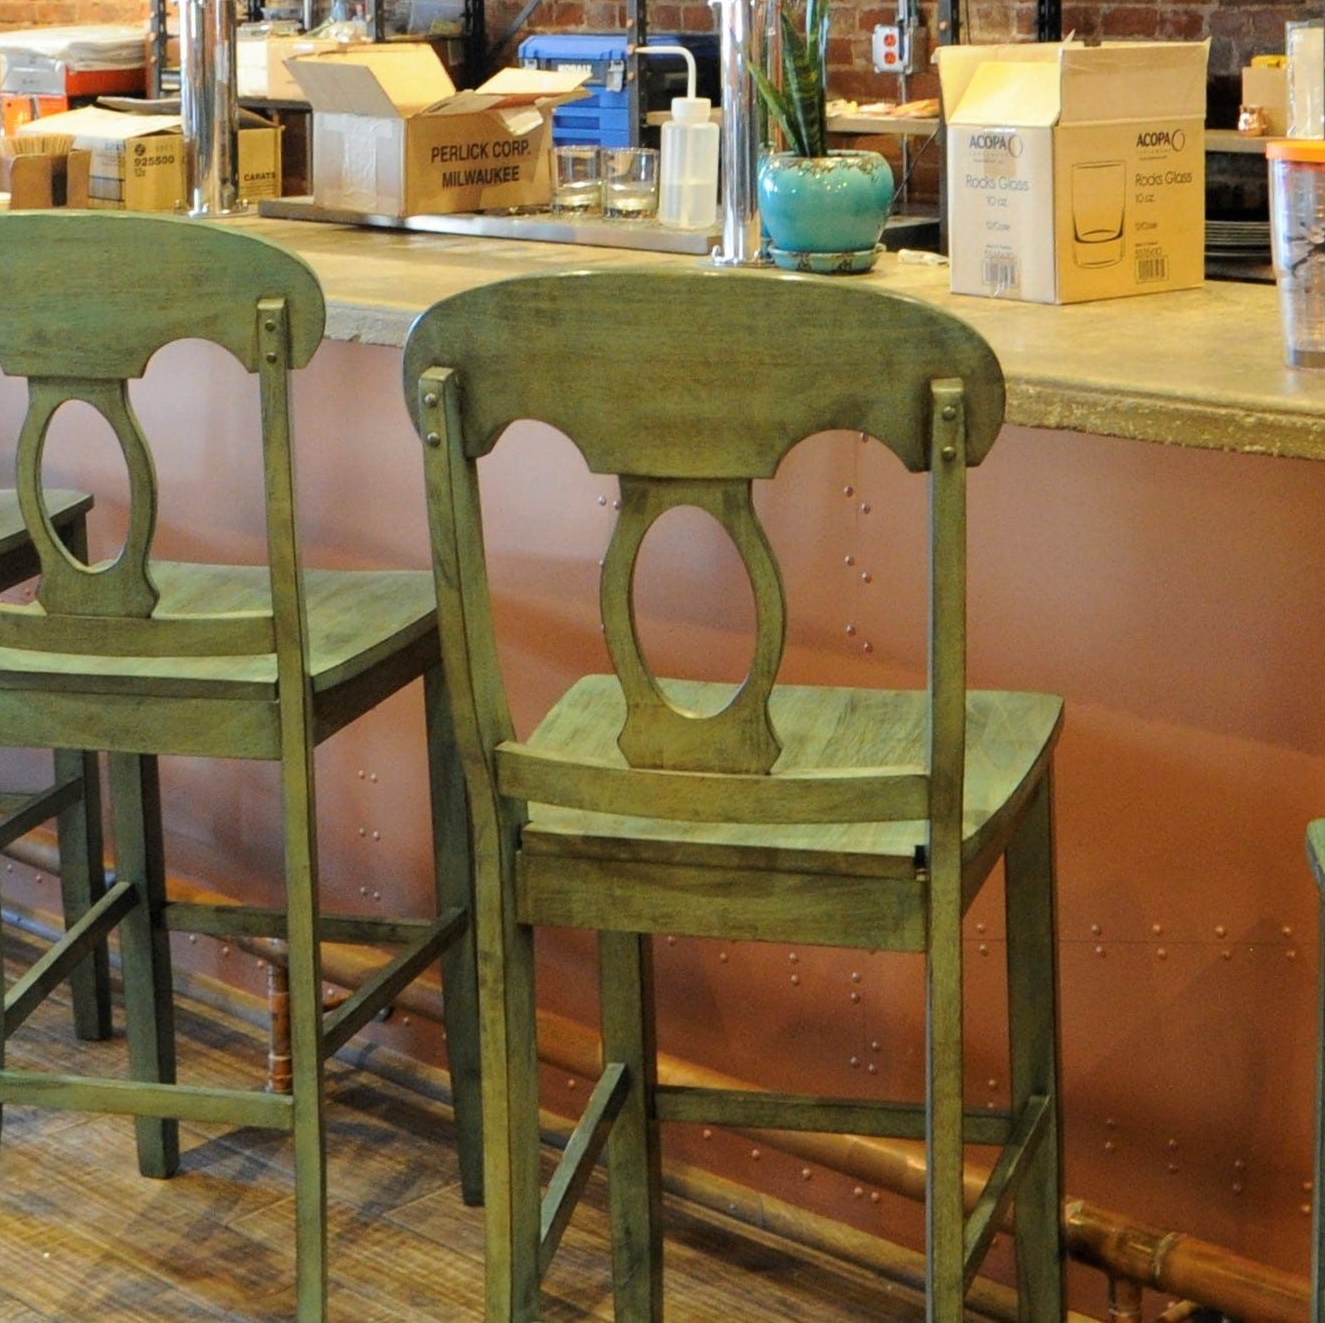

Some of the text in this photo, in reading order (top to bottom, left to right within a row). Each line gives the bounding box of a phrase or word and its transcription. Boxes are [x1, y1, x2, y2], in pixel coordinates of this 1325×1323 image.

[968, 134, 1007, 150] ACOPA
[1135, 131, 1171, 148] ACOPA
[431, 139, 532, 164] PERLICK CORP.
[441, 165, 520, 189] MILWAUKEE
[998, 176, 1029, 192] Glass
[1164, 171, 1193, 185] Glass
